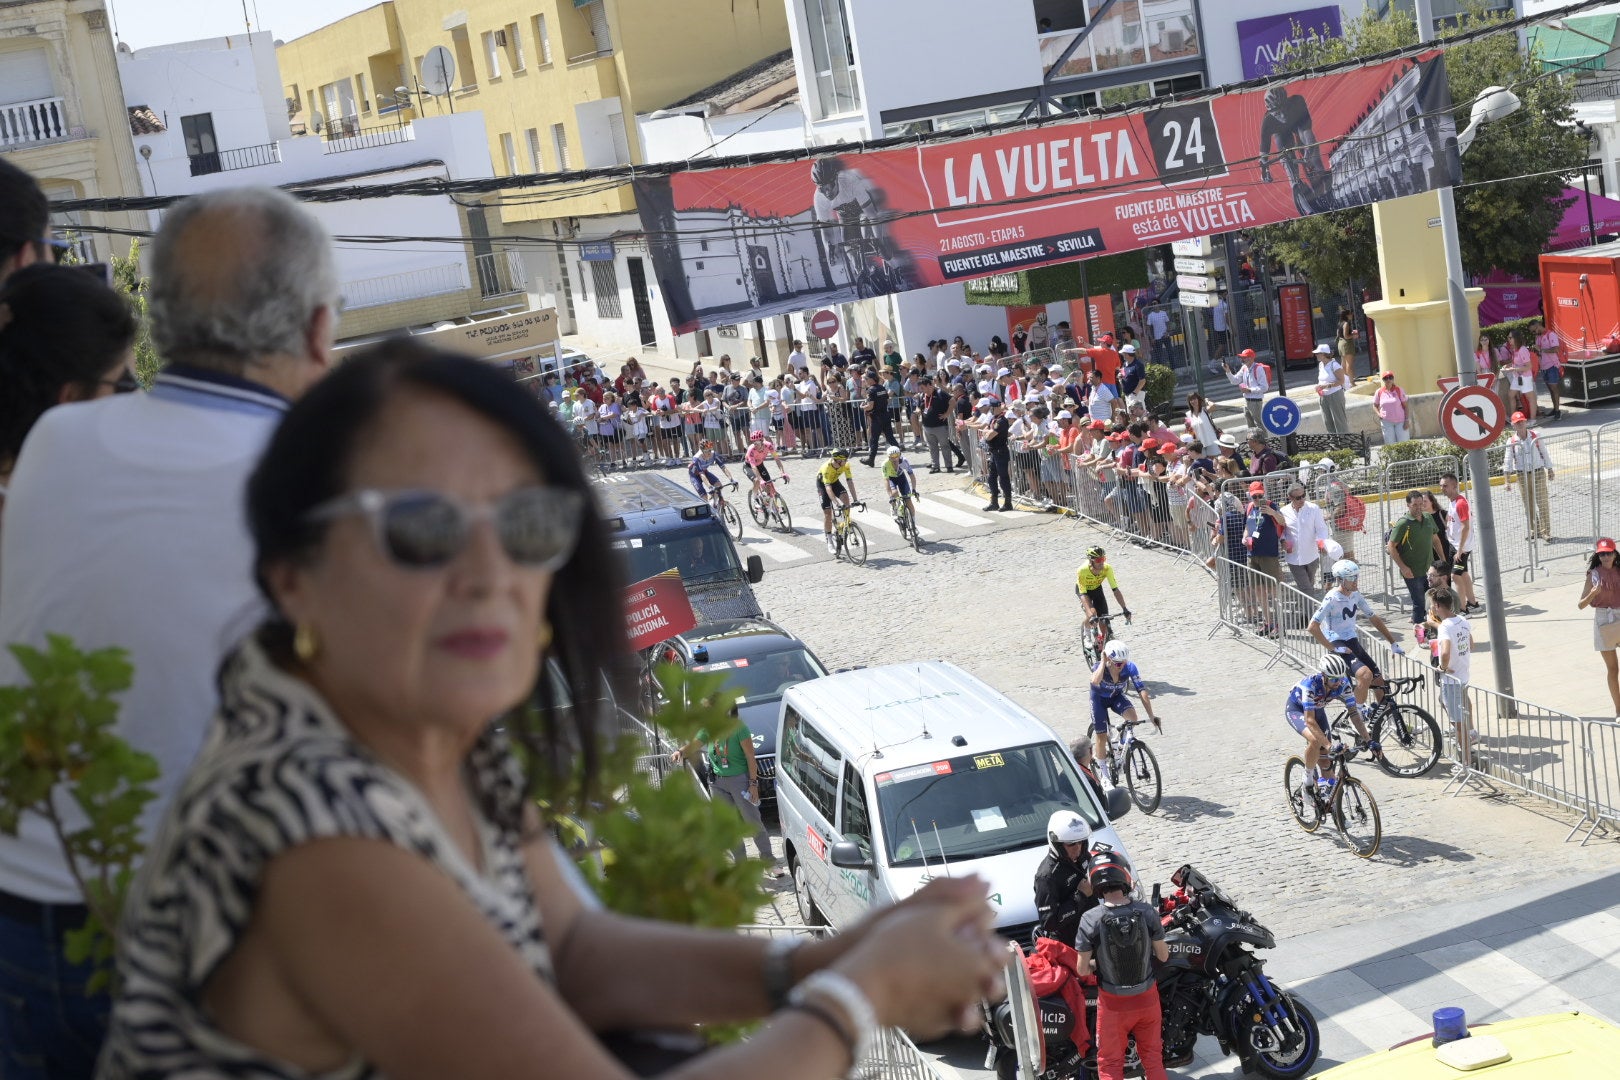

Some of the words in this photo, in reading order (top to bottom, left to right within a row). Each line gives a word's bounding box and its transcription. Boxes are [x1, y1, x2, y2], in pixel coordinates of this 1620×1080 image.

[1254, 34, 1325, 65] AVAT
[944, 153, 992, 206] LA
[995, 129, 1139, 196] VUELTA
[1163, 117, 1206, 169] 24
[1115, 200, 1155, 220] FUENTE
[1157, 197, 1175, 213] DEL
[1176, 187, 1224, 209] MAESTRE
[1133, 215, 1161, 235] está
[1163, 213, 1179, 230] de
[1179, 199, 1255, 233] VUELTA
[940, 239, 950, 251] 21
[952, 233, 985, 250] AGOSTO
[991, 227, 1018, 243] ETAPA
[1019, 225, 1025, 238] 5
[944, 256, 983, 273] FUENTE
[982, 253, 1001, 267] DEL
[1001, 244, 1045, 264] MAESTRE
[1057, 235, 1095, 253] SEVILLA
[626, 603, 661, 625] POLICÍA
[626, 616, 669, 640] NACIONAL
[976, 756, 1002, 768] META
[1168, 943, 1201, 954] alicia
